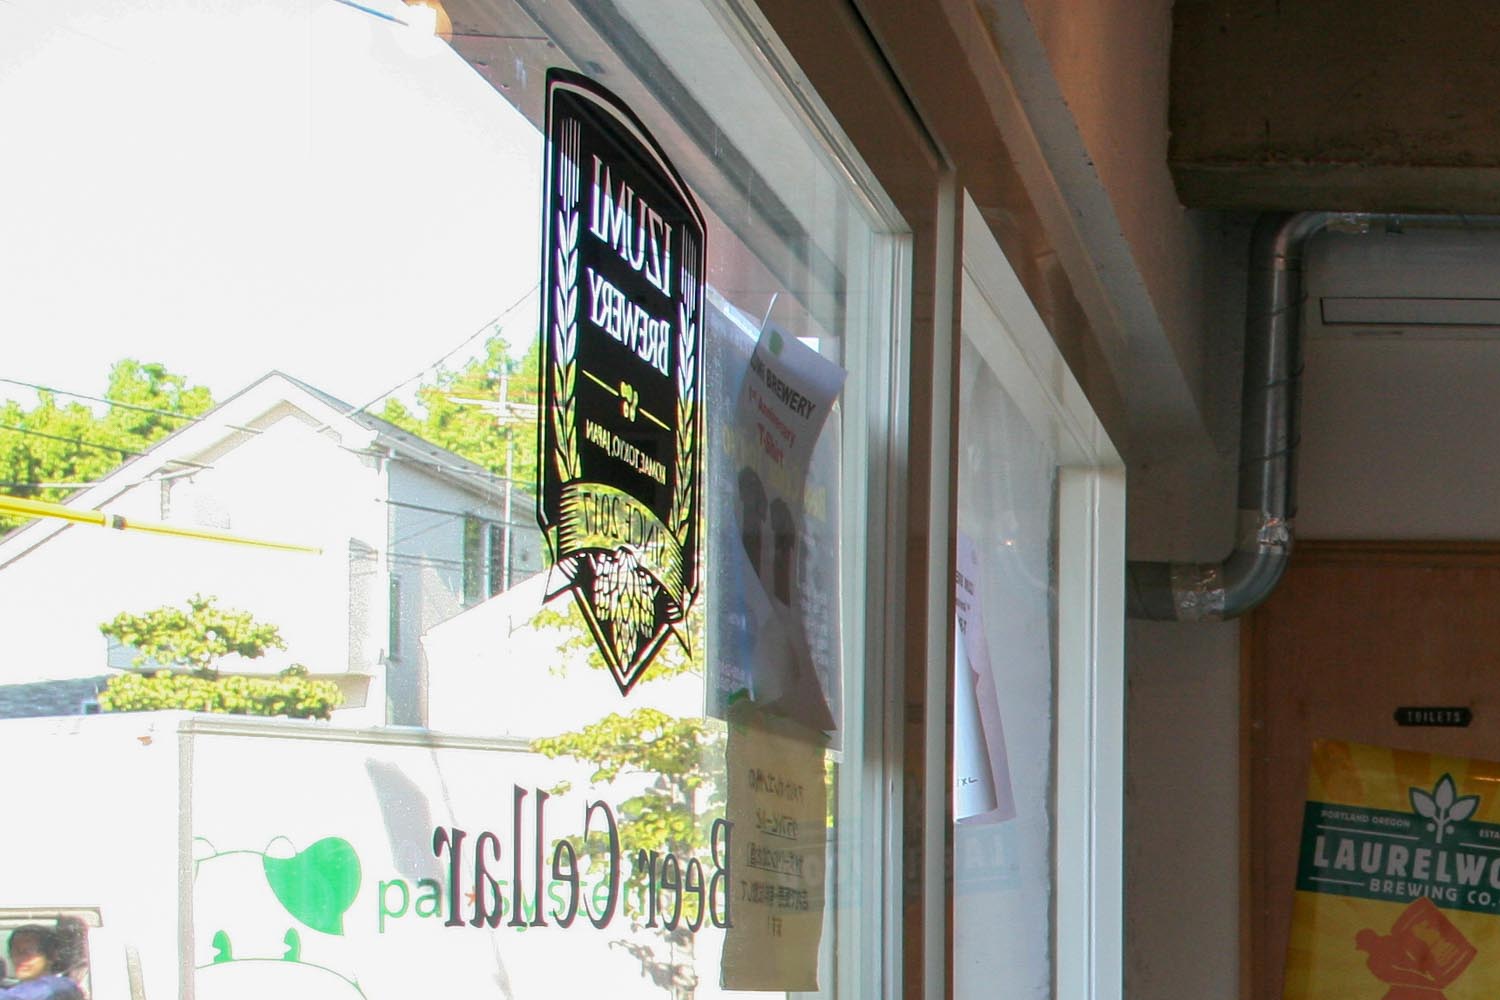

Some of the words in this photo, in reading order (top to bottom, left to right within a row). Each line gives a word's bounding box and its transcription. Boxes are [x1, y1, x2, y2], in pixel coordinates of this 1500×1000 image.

[766, 367, 818, 420] BREWERY
[1407, 710, 1461, 723] TOILETS
[1320, 809, 1369, 824] PORTLAND
[1371, 816, 1411, 829] OREGON
[1369, 877, 1458, 902] BREWING
[1467, 889, 1497, 908] CO.
